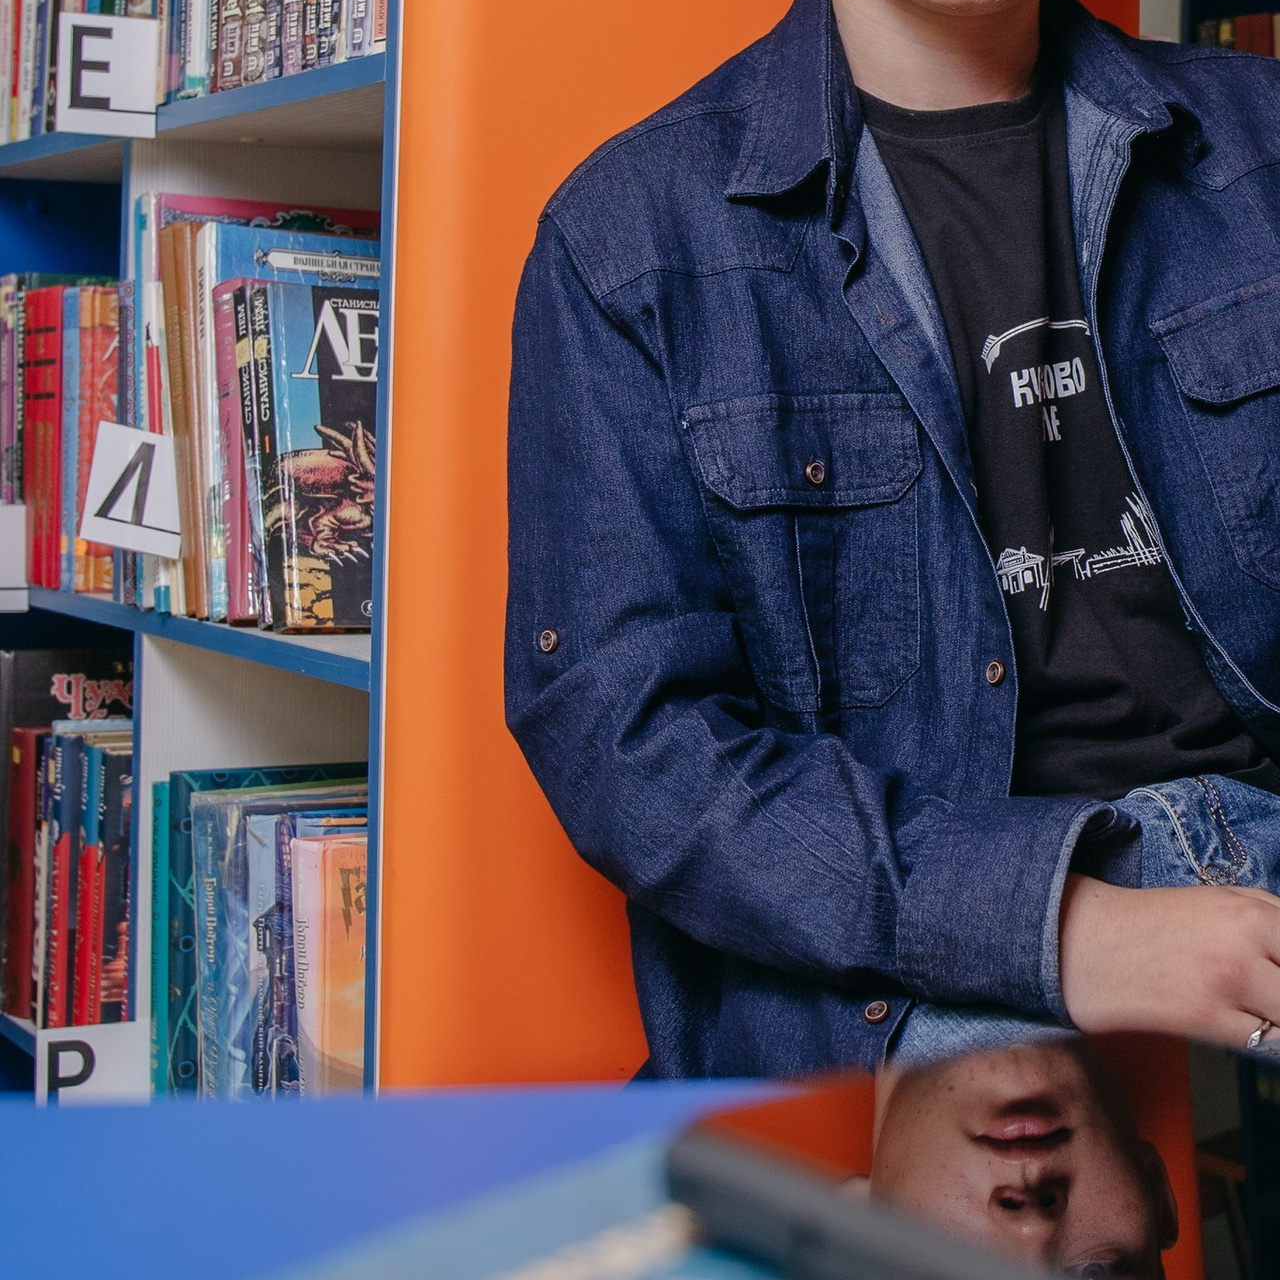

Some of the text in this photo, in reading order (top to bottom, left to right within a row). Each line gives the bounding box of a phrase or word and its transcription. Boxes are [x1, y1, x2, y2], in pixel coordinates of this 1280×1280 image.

[378, 23, 387, 35] НА
[68, 24, 113, 110] Е
[293, 256, 380, 274] ВОЛШЕБНАЯ СТРАНА
[237, 303, 248, 336] ЛЕМ
[253, 299, 266, 332] ЛЕМ
[291, 299, 380, 382] ЛЕ
[93, 442, 156, 526] Л
[204, 877, 217, 915] Гарри
[206, 916, 218, 964] Поттер
[47, 1039, 96, 1104] Р
